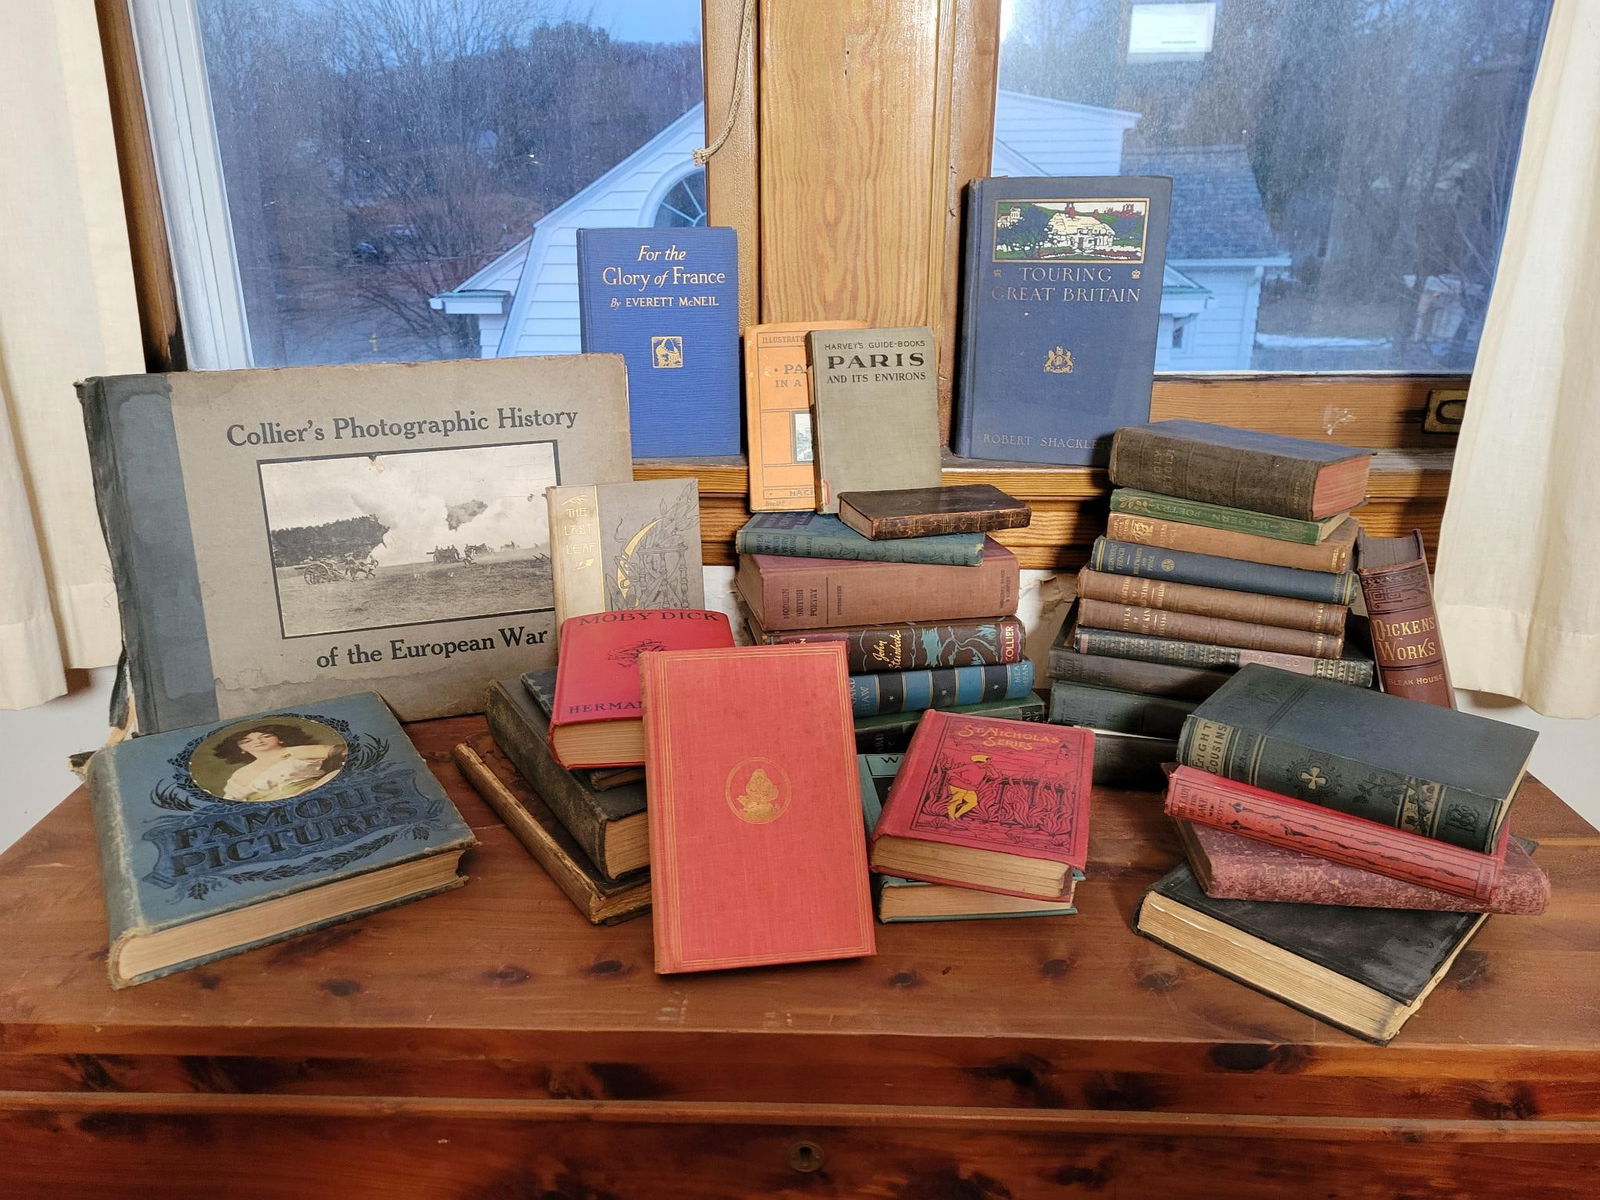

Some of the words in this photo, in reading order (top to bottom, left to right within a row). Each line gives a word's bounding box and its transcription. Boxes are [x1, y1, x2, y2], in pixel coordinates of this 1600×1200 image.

[637, 245, 661, 261] For
[664, 244, 687, 261] the
[602, 266, 651, 292] Glory
[653, 270, 669, 288] of
[672, 266, 726, 285] France
[1018, 267, 1112, 282] TOURING
[991, 287, 1055, 301] GREAT
[1063, 287, 1141, 302] BRITAIN
[610, 297, 621, 310] By
[625, 297, 674, 307] EVERETT
[679, 296, 719, 307] McNEIL
[824, 342, 864, 351] HARVEY'S
[868, 340, 926, 349] GUIDE-BOOKS
[784, 363, 806, 374] PA
[827, 352, 925, 370] PARIS
[775, 379, 788, 388] IN
[826, 375, 847, 384] AND
[852, 374, 869, 383] ITS
[874, 371, 926, 382] ENVIRONS
[226, 419, 325, 447] Collier's
[333, 410, 489, 440] Photographic
[497, 407, 578, 429] History
[982, 433, 1033, 446] ROBERT
[1040, 437, 1099, 449] SHACKLE
[567, 508, 588, 518] THE
[1156, 504, 1201, 518] POETRY
[563, 524, 593, 536] LAST
[566, 542, 596, 555] LEAF
[579, 612, 651, 626] MOBY
[662, 611, 719, 622] DICK
[1372, 616, 1436, 641] DICKENS
[316, 646, 339, 668] of
[347, 643, 383, 665] the
[390, 635, 495, 661] European
[498, 626, 548, 648] War
[872, 640, 887, 662] John
[1005, 625, 1014, 662] COLLIER
[1377, 637, 1436, 661] WORKS
[1416, 674, 1444, 685] HOUSE
[981, 727, 1060, 744] NICHOLAS
[983, 736, 1033, 751] SERIES
[1192, 722, 1213, 769] EIGHT
[1206, 725, 1228, 774] COUSINS
[174, 778, 402, 852] FAMOUS
[172, 803, 421, 878] PICTURES
